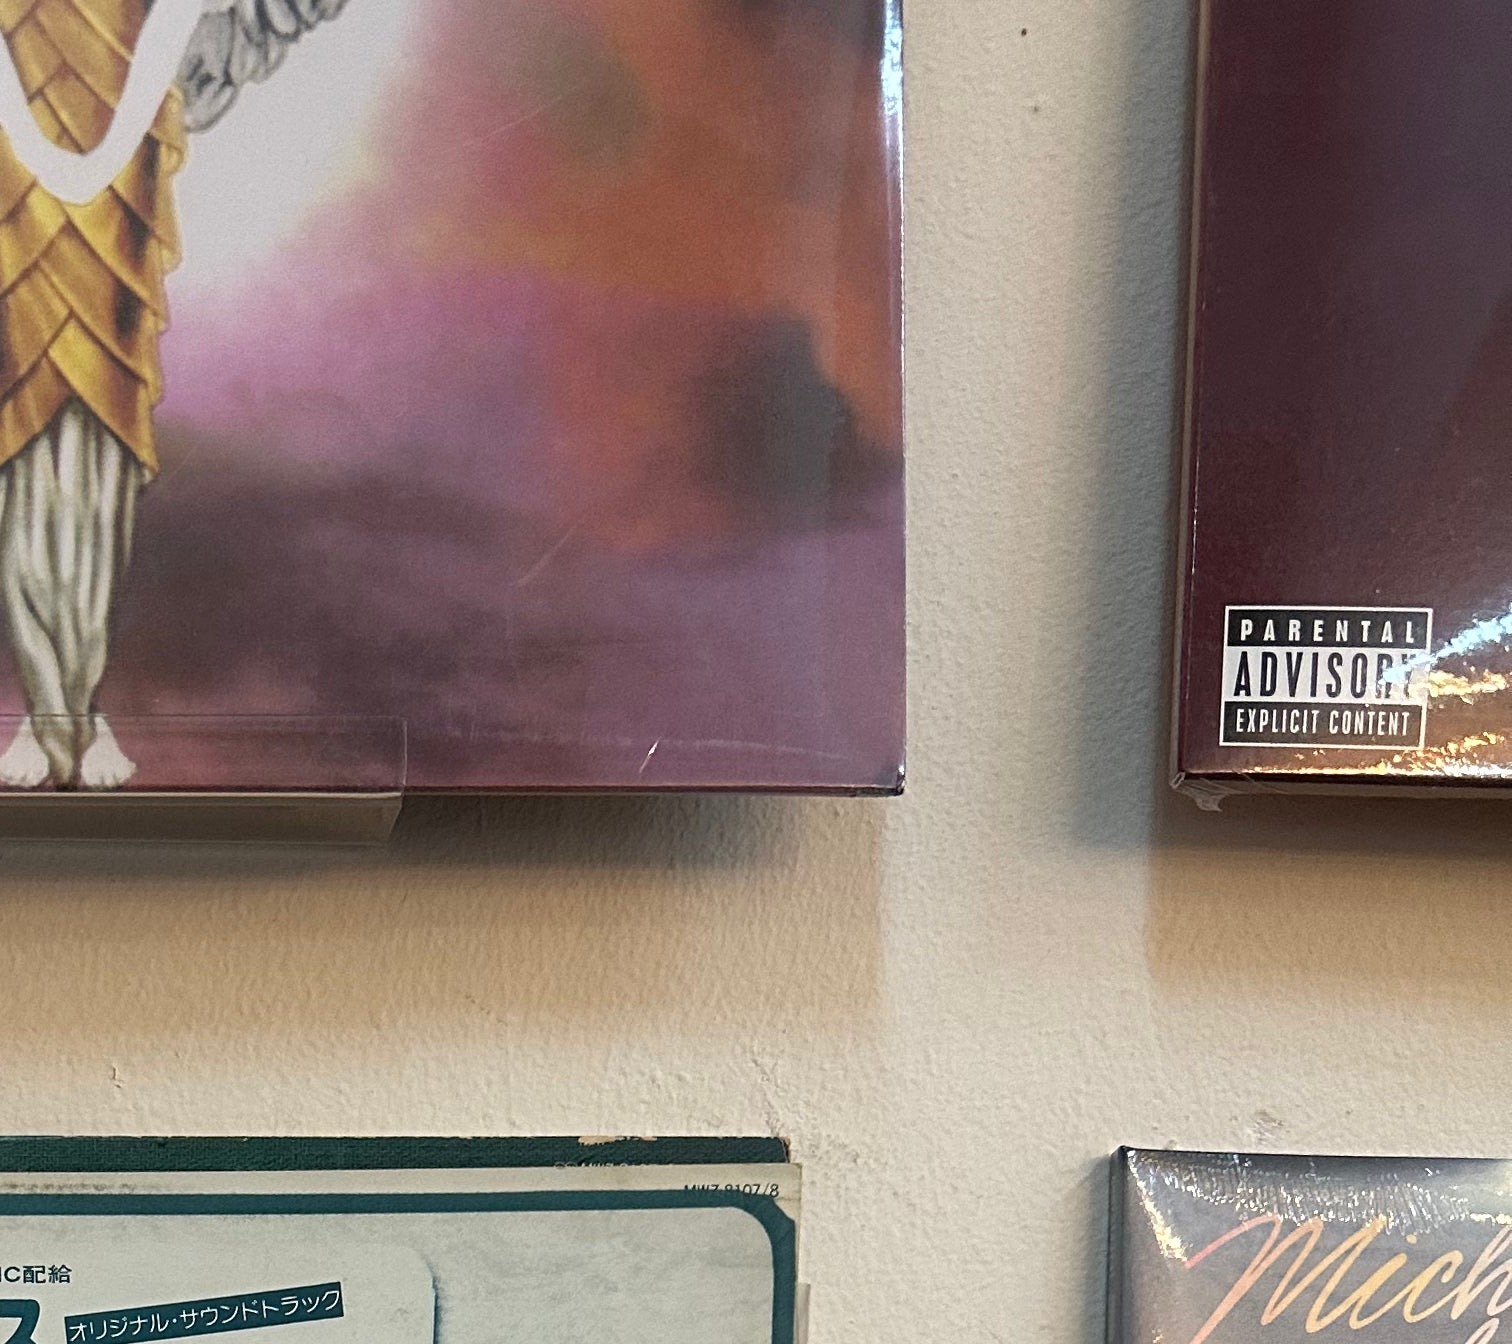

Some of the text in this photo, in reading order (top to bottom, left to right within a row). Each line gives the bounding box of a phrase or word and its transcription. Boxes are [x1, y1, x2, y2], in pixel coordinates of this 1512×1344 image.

[1240, 619, 1415, 644] PARENTAL
[1233, 651, 1424, 699] ADVISOR
[1236, 708, 1410, 737] EXPLICIT CONTENT
